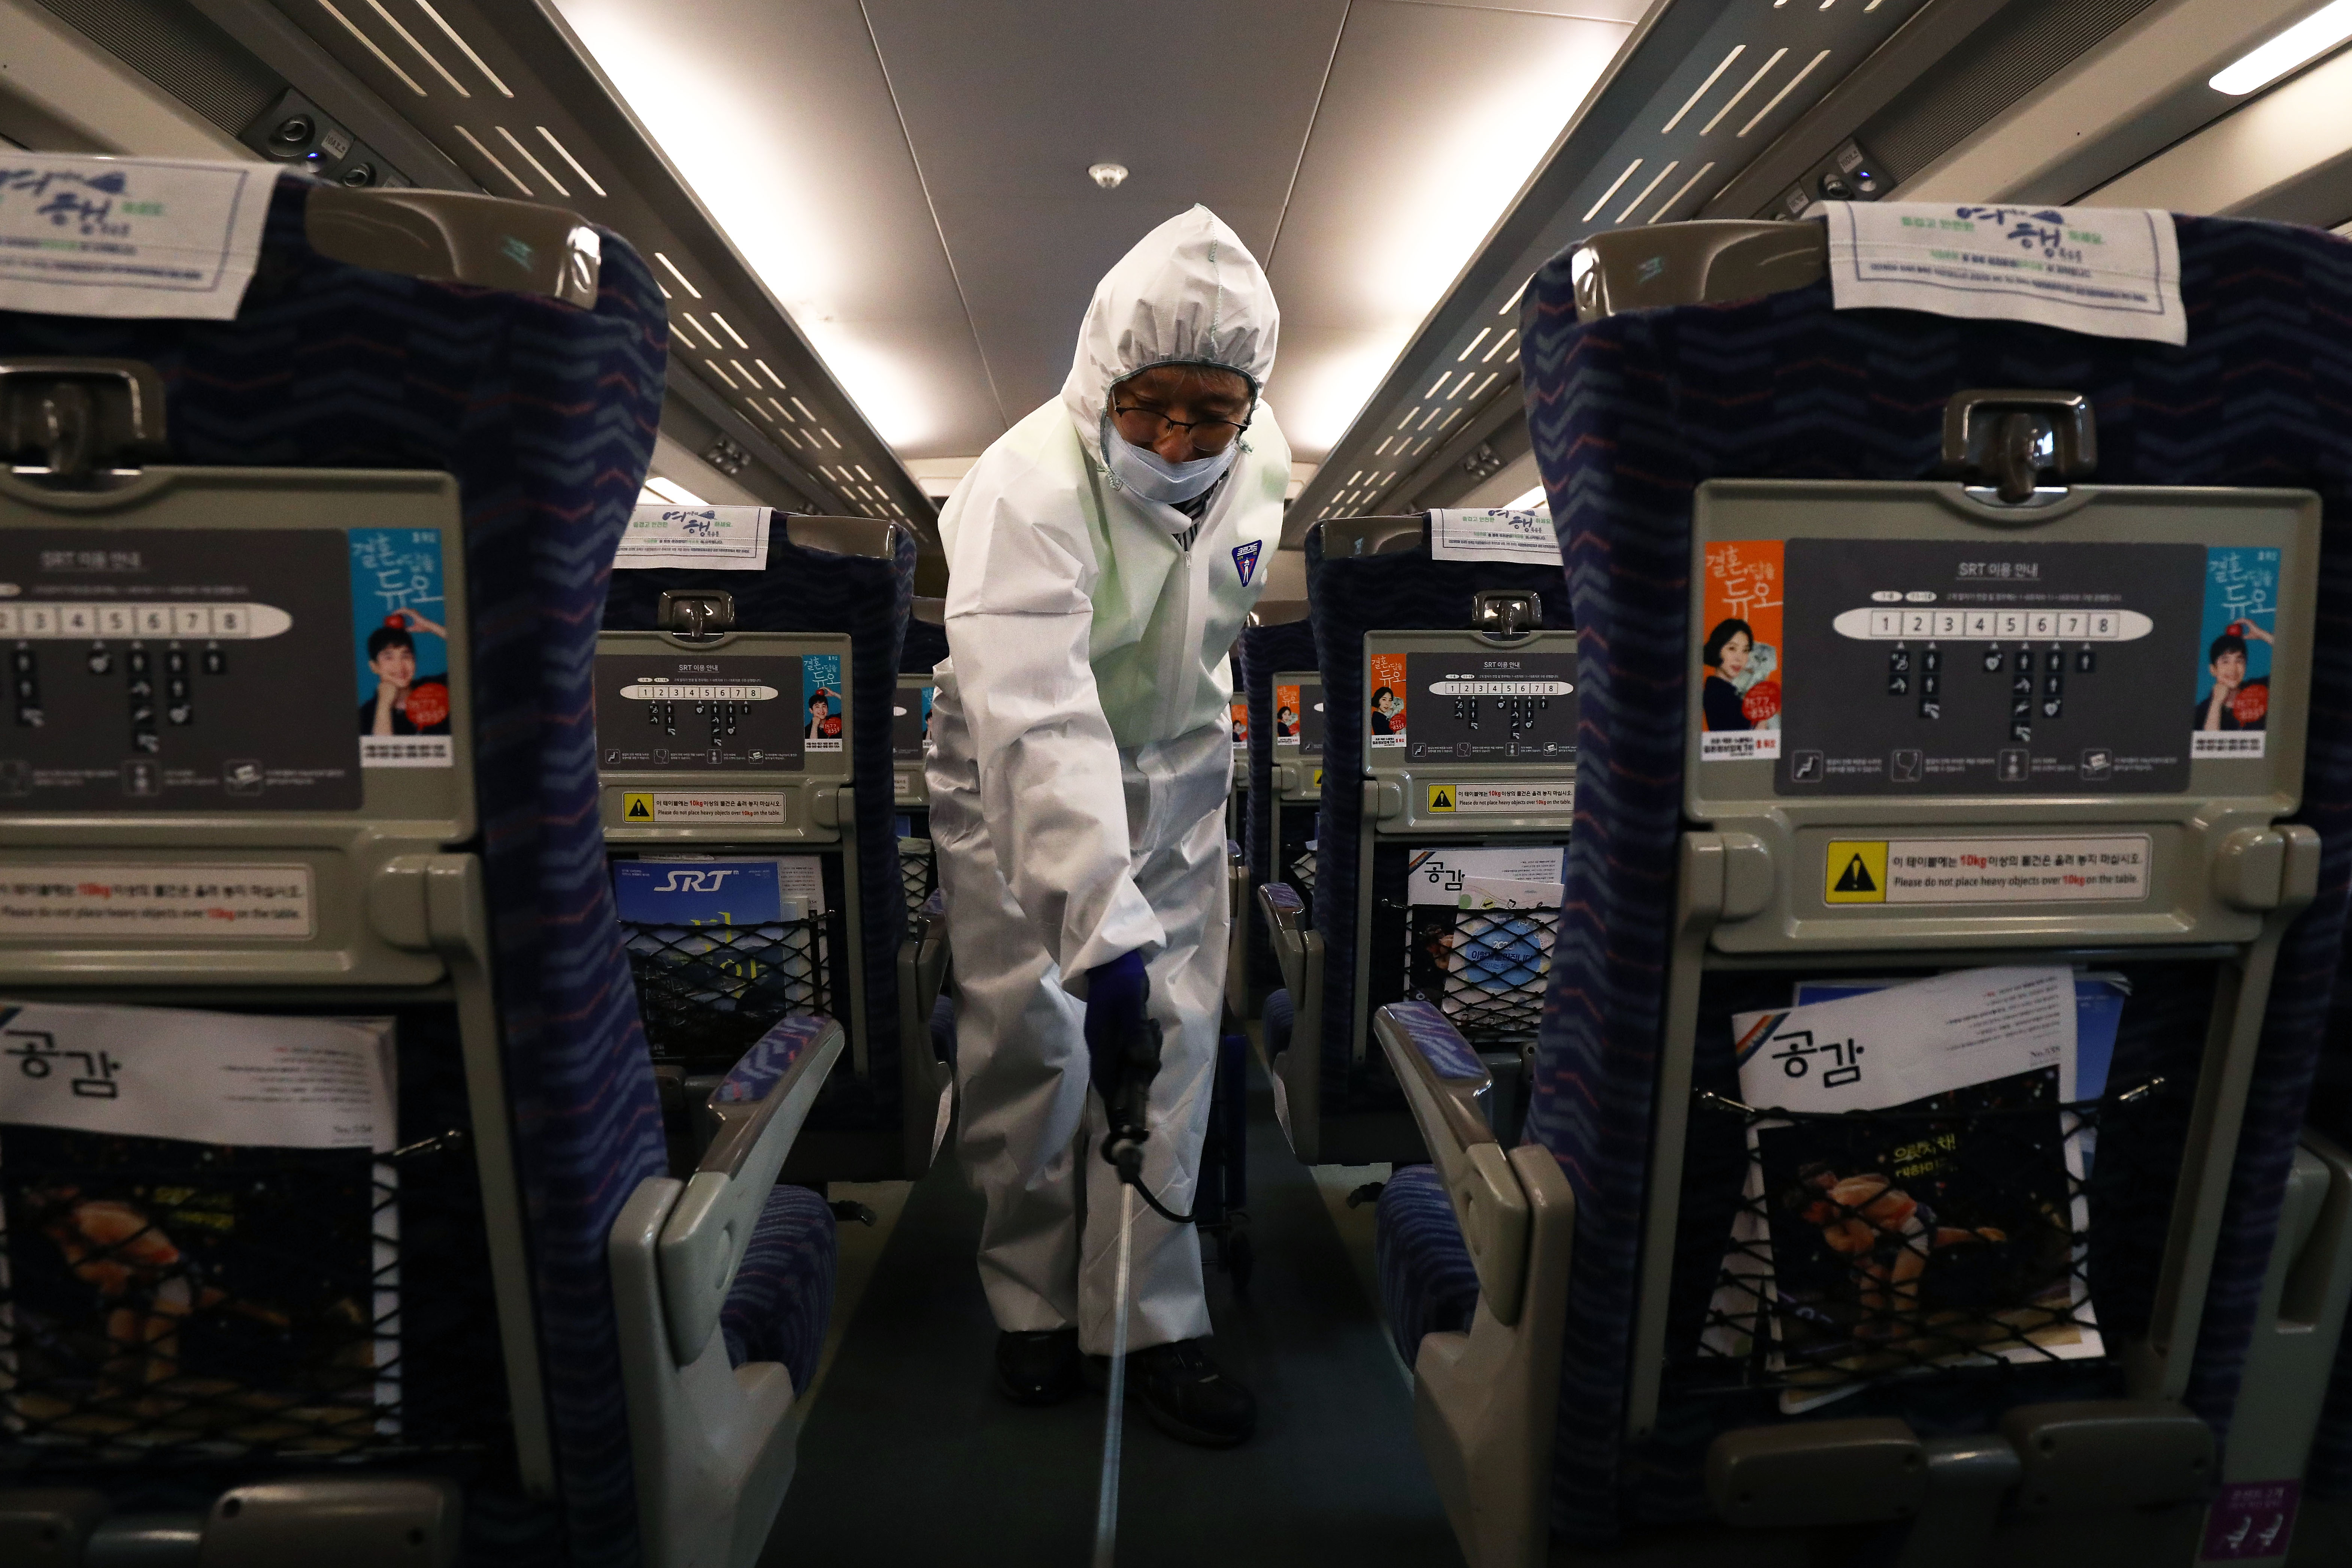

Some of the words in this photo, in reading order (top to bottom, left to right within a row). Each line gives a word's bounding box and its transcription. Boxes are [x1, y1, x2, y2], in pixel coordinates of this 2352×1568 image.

[662, 511, 710, 537] 여행
[1488, 510, 1533, 532] 여행
[1237, 543, 1258, 554] 크린가드
[375, 570, 444, 611] 듀오
[1722, 577, 1783, 624] 듀오
[2221, 583, 2277, 620] 듀오
[34, 613, 46, 630] 3
[72, 613, 84, 630] 4
[111, 613, 122, 630] 5
[149, 613, 160, 630] 6
[187, 613, 198, 630] 7
[224, 613, 236, 630] 8
[1883, 618, 1889, 632] 1
[1913, 618, 1922, 632] 2
[1945, 618, 1954, 632] 3
[1976, 618, 1985, 632] 4
[2007, 618, 2016, 632] 5
[2037, 618, 2046, 632] 6
[2069, 618, 2077, 632] 7
[2100, 618, 2109, 632] 8
[812, 671, 841, 688] 듀오
[1379, 669, 1406, 689] 듀오
[1960, 854, 1986, 869] 10kg
[654, 870, 732, 892] SRT
[1424, 862, 1465, 891] 공감
[1895, 877, 1922, 887] Please
[1925, 877, 1936, 886] do
[1938, 877, 1953, 886] not
[1955, 877, 1978, 889] place
[1980, 877, 2007, 888] heavy
[2009, 876, 2039, 887] objects
[2041, 877, 2060, 886] over
[2063, 875, 2085, 887] 10kg
[2099, 875, 2113, 883] the
[4, 1029, 121, 1099] 공감
[1772, 1031, 1865, 1088] 공감
